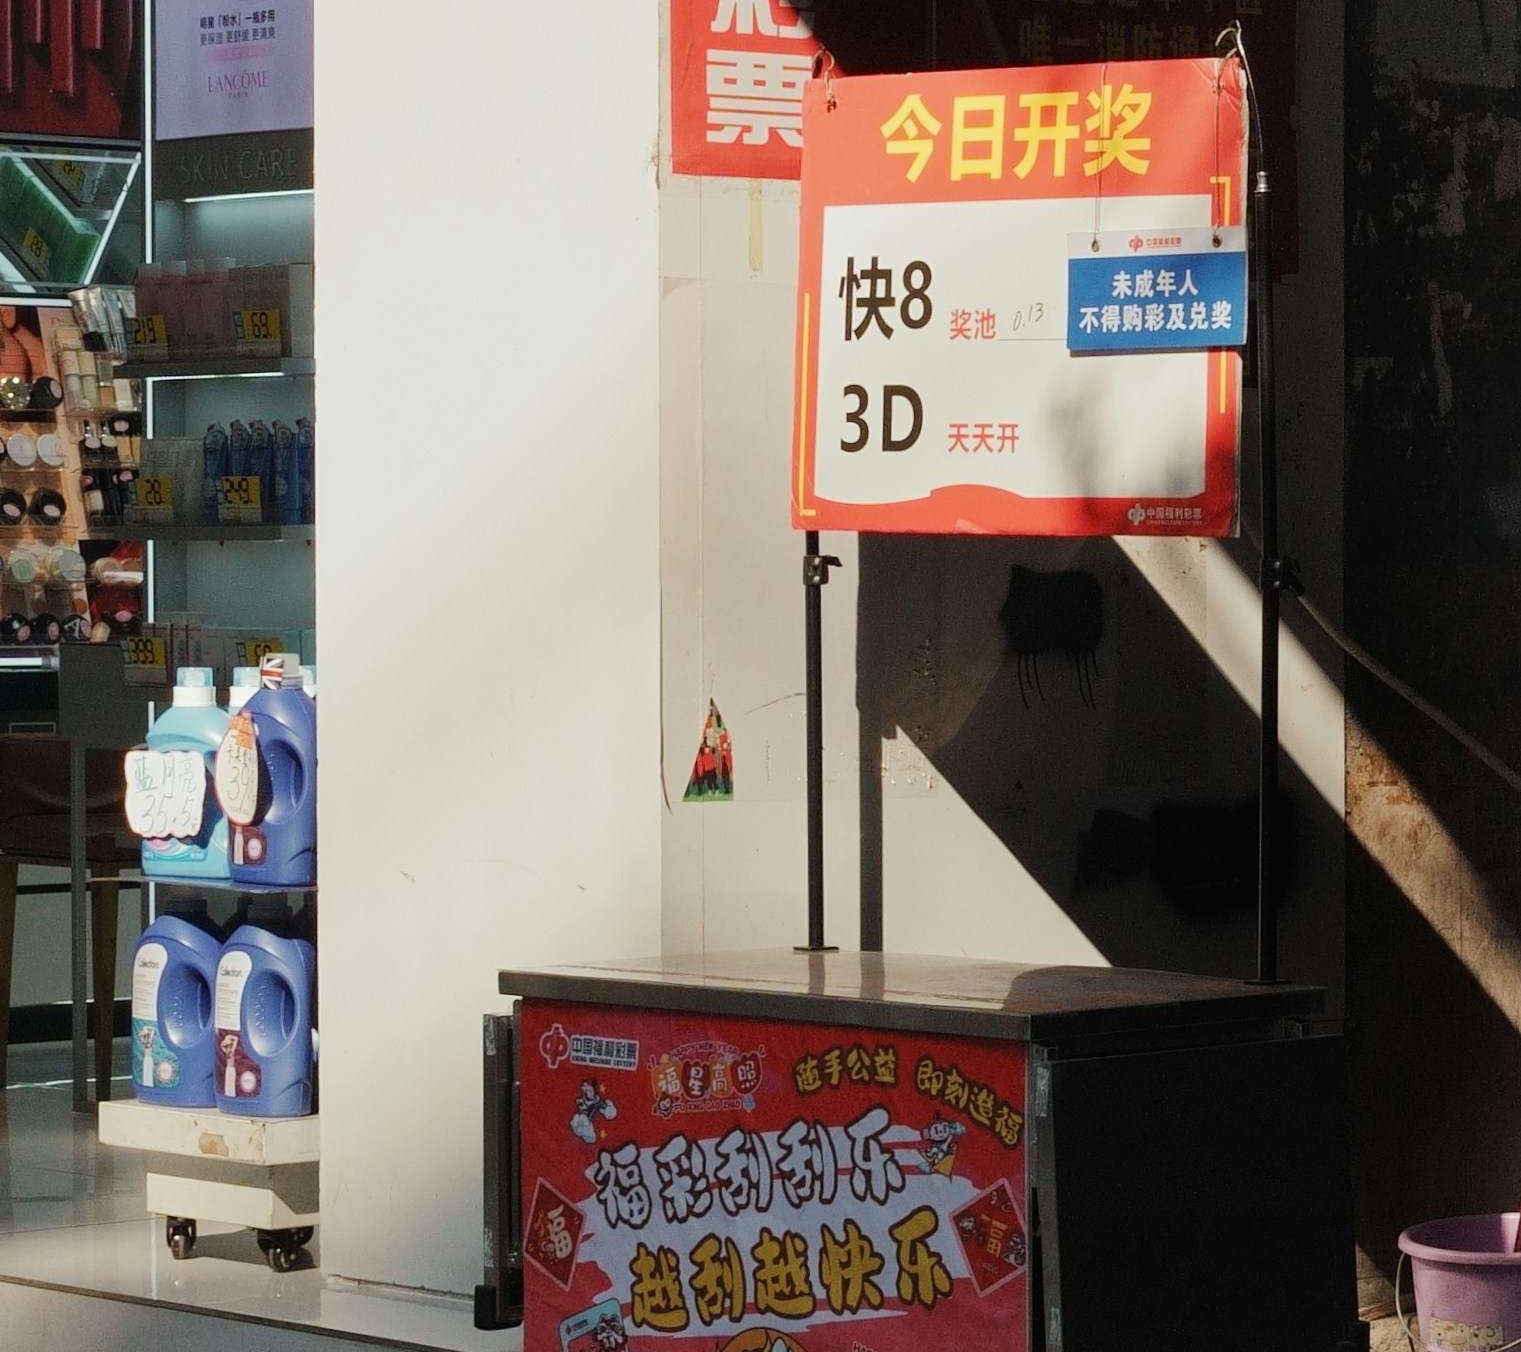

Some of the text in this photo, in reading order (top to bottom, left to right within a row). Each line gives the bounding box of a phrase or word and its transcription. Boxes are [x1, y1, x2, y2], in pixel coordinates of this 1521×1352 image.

[207, 68, 270, 94] LANCÔME
[879, 83, 1154, 183] 今日开奖
[179, 147, 298, 184] SKIN CARE
[838, 256, 933, 342] 快8
[1111, 268, 1199, 300] 未成年人
[949, 308, 997, 341] 奖池
[1011, 302, 1045, 333] 0.13
[1078, 299, 1233, 334] 不得购彩及兑奖
[839, 384, 923, 453] 3D
[948, 422, 1020, 454] 天天开
[134, 755, 199, 799] 蓝月亮
[570, 1035, 639, 1060] 中国福利彩票
[657, 1059, 760, 1097] 福星高照
[793, 1043, 900, 1094] 随手公益
[915, 1059, 1025, 1148] 即刻造福
[594, 1108, 905, 1228] 福彩刮刮乐
[628, 1206, 952, 1332] 越刮越快乐
